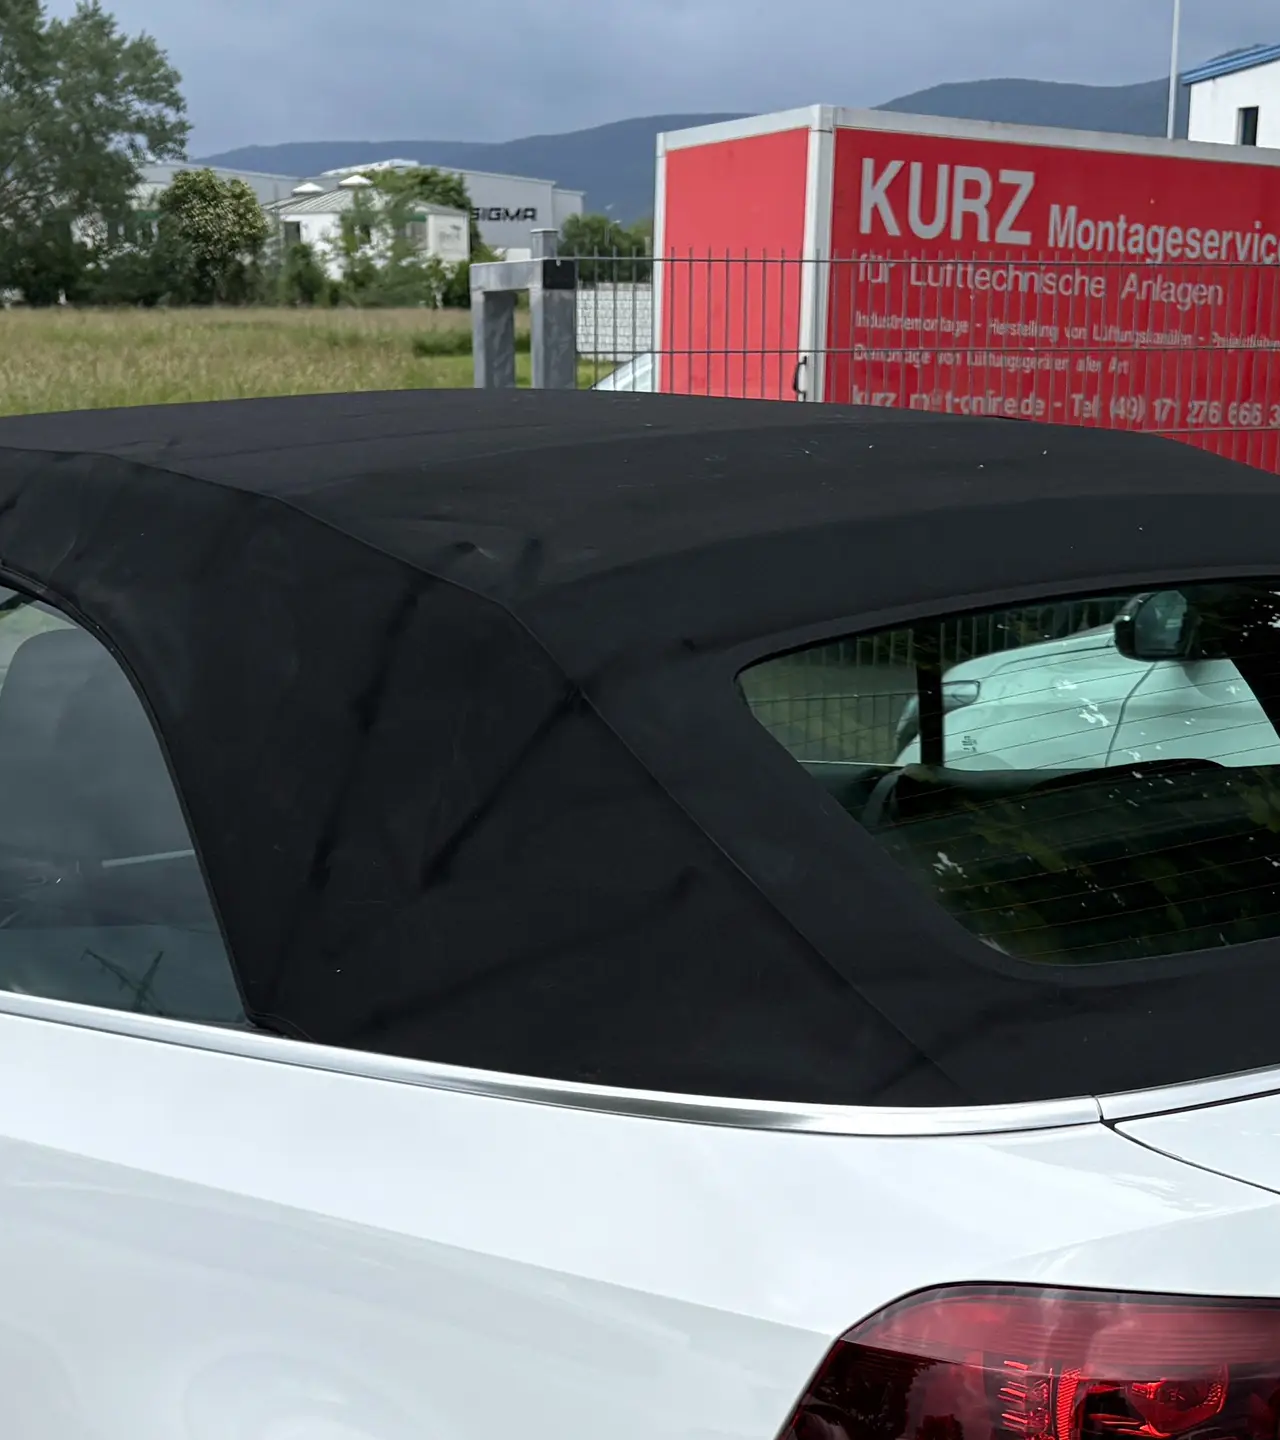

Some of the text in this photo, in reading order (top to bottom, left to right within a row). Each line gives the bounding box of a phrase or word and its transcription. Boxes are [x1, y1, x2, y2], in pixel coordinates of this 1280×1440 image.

[859, 157, 1036, 246] KURZ
[858, 253, 1224, 312] für Lufttechnische Anlagen
[1064, 325, 1087, 341] von
[1108, 355, 1128, 376] Art
[1186, 400, 1221, 425] 276
